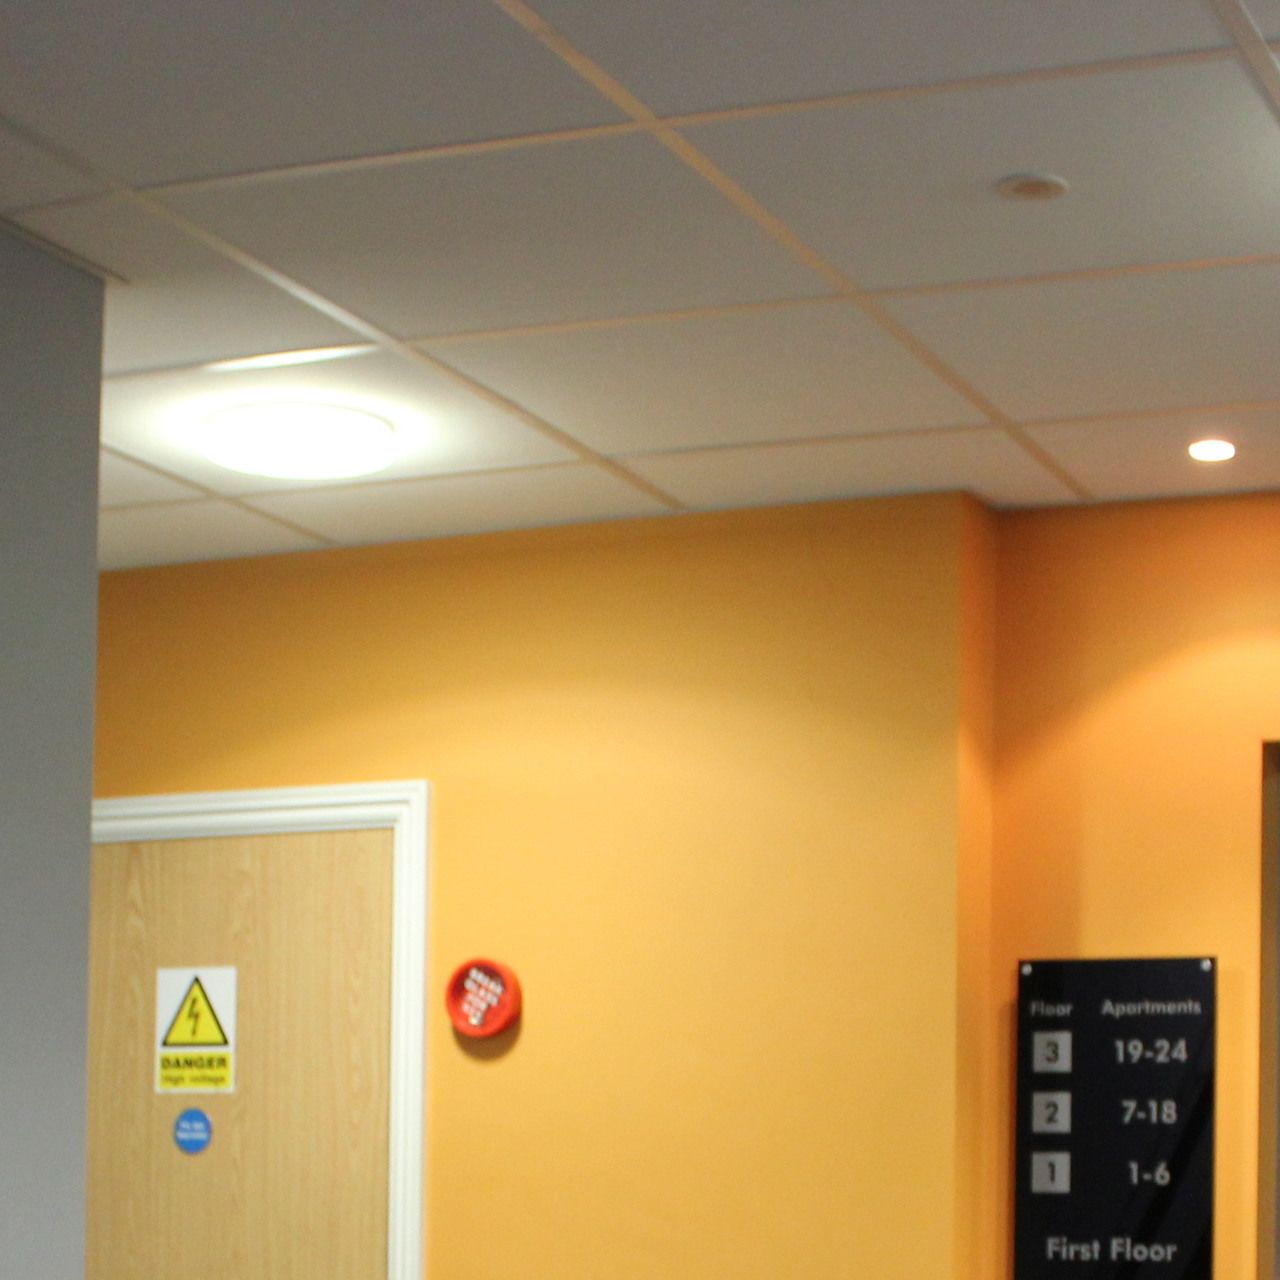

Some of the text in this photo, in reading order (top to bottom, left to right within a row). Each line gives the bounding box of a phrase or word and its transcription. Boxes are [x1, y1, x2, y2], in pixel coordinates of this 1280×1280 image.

[1031, 998, 1202, 1019] Floor Apartments
[161, 1056, 227, 1070] DANGER
[1045, 1038, 1188, 1064] 3 19-24
[1045, 1100, 1177, 1125] 2 7-18
[1047, 1161, 1170, 1186] 1 1-6
[1046, 1236, 1178, 1262] First Floor
